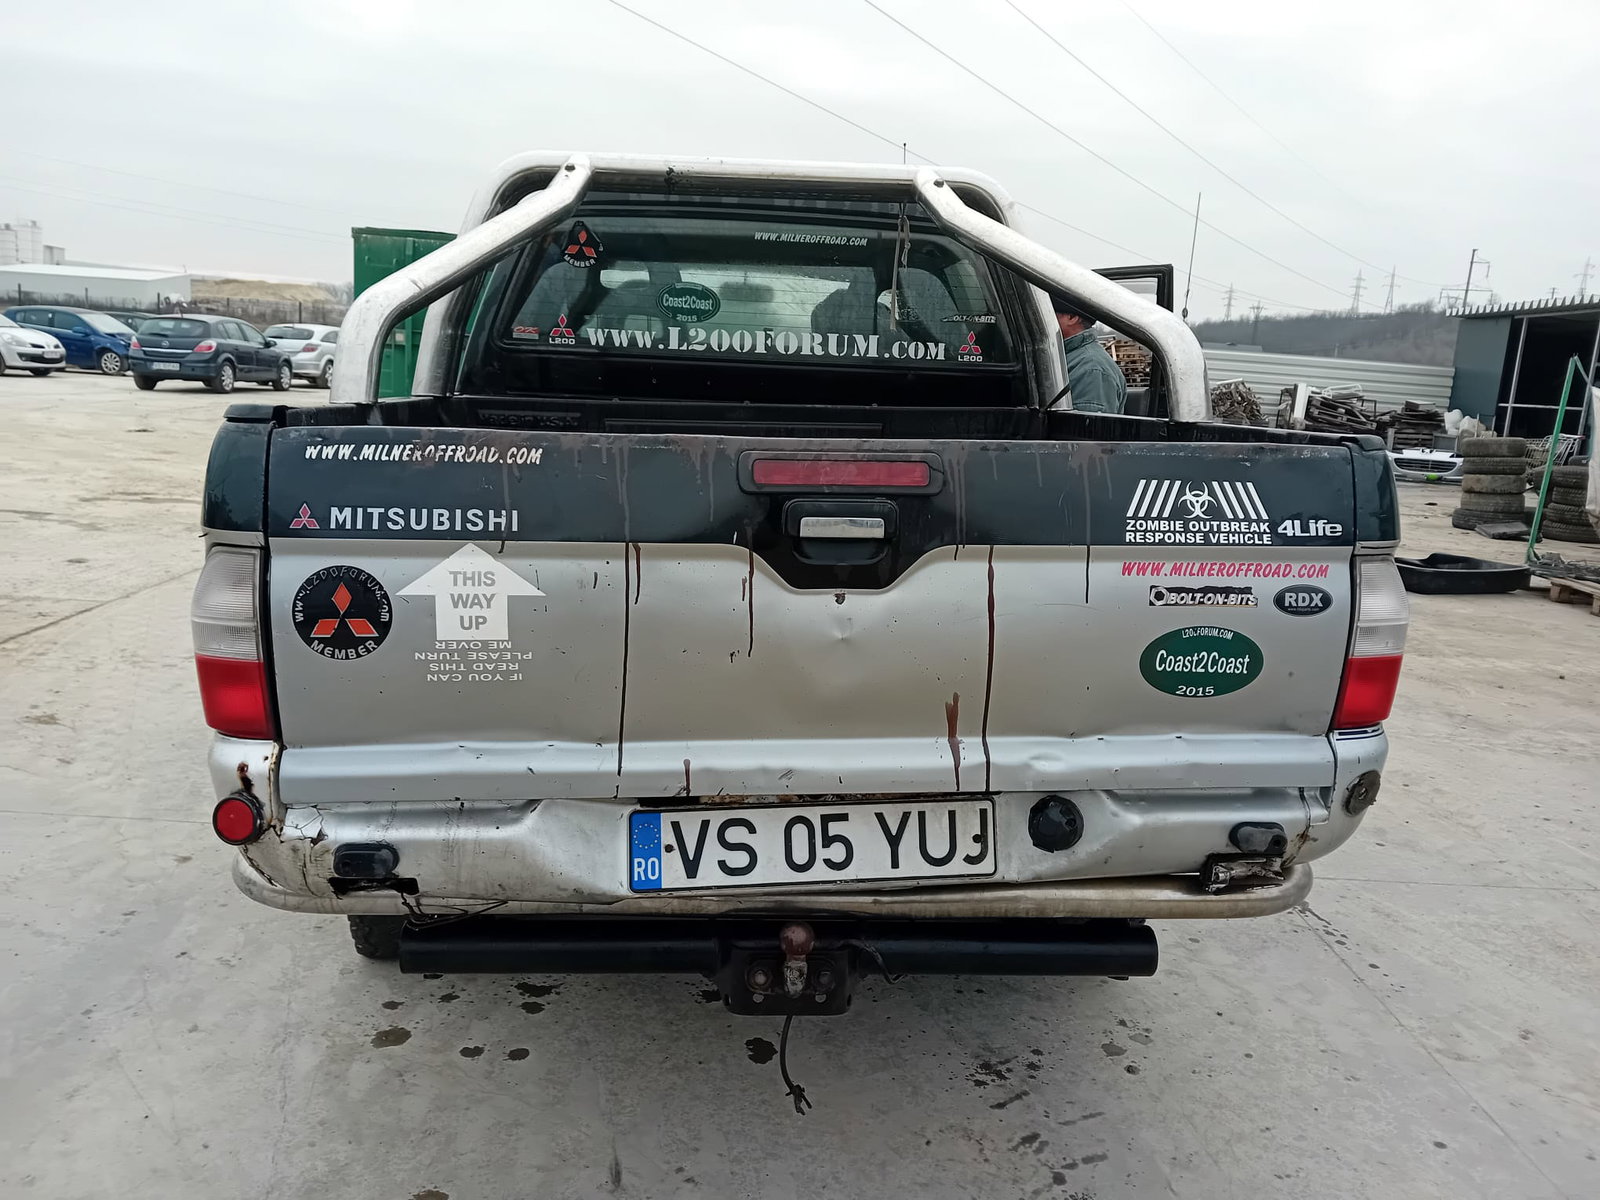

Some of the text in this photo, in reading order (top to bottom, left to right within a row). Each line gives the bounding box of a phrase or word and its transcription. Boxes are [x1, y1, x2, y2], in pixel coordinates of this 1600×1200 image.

[754, 231, 868, 247] WWW.MILNEROFFROAD.COM
[563, 254, 596, 268] MEMBER
[662, 293, 713, 311] Coast2Coast
[676, 313, 698, 322] 2015
[549, 337, 576, 345] L200
[305, 443, 543, 465] WWW.MILNEROFFROAD.COM
[330, 506, 519, 533] MITSUBISHI
[1125, 519, 1271, 533] ZOMBIE OUTBREAK
[1277, 519, 1343, 537] 4Life
[1125, 532, 1273, 545] RESPONSE VEHICLE
[1121, 560, 1330, 578] WWW.MILNEROFFROAD.COM
[448, 570, 497, 587] THIS
[449, 593, 497, 609] WAY
[1166, 591, 1258, 606] BOLT-ON-BITS
[1284, 592, 1324, 607] RDX
[459, 615, 488, 631] UP
[310, 639, 378, 660] MEMBER
[434, 641, 512, 649] ME OVER
[414, 651, 533, 660] PLEASE TURN
[1155, 649, 1250, 675] Coast2Coast
[429, 662, 519, 671] READ THIS
[427, 673, 462, 681] CAN
[468, 673, 504, 681] YOU
[1175, 685, 1215, 697] 2015
[670, 808, 989, 879] VS 05 YUJ
[633, 857, 660, 881] RO
